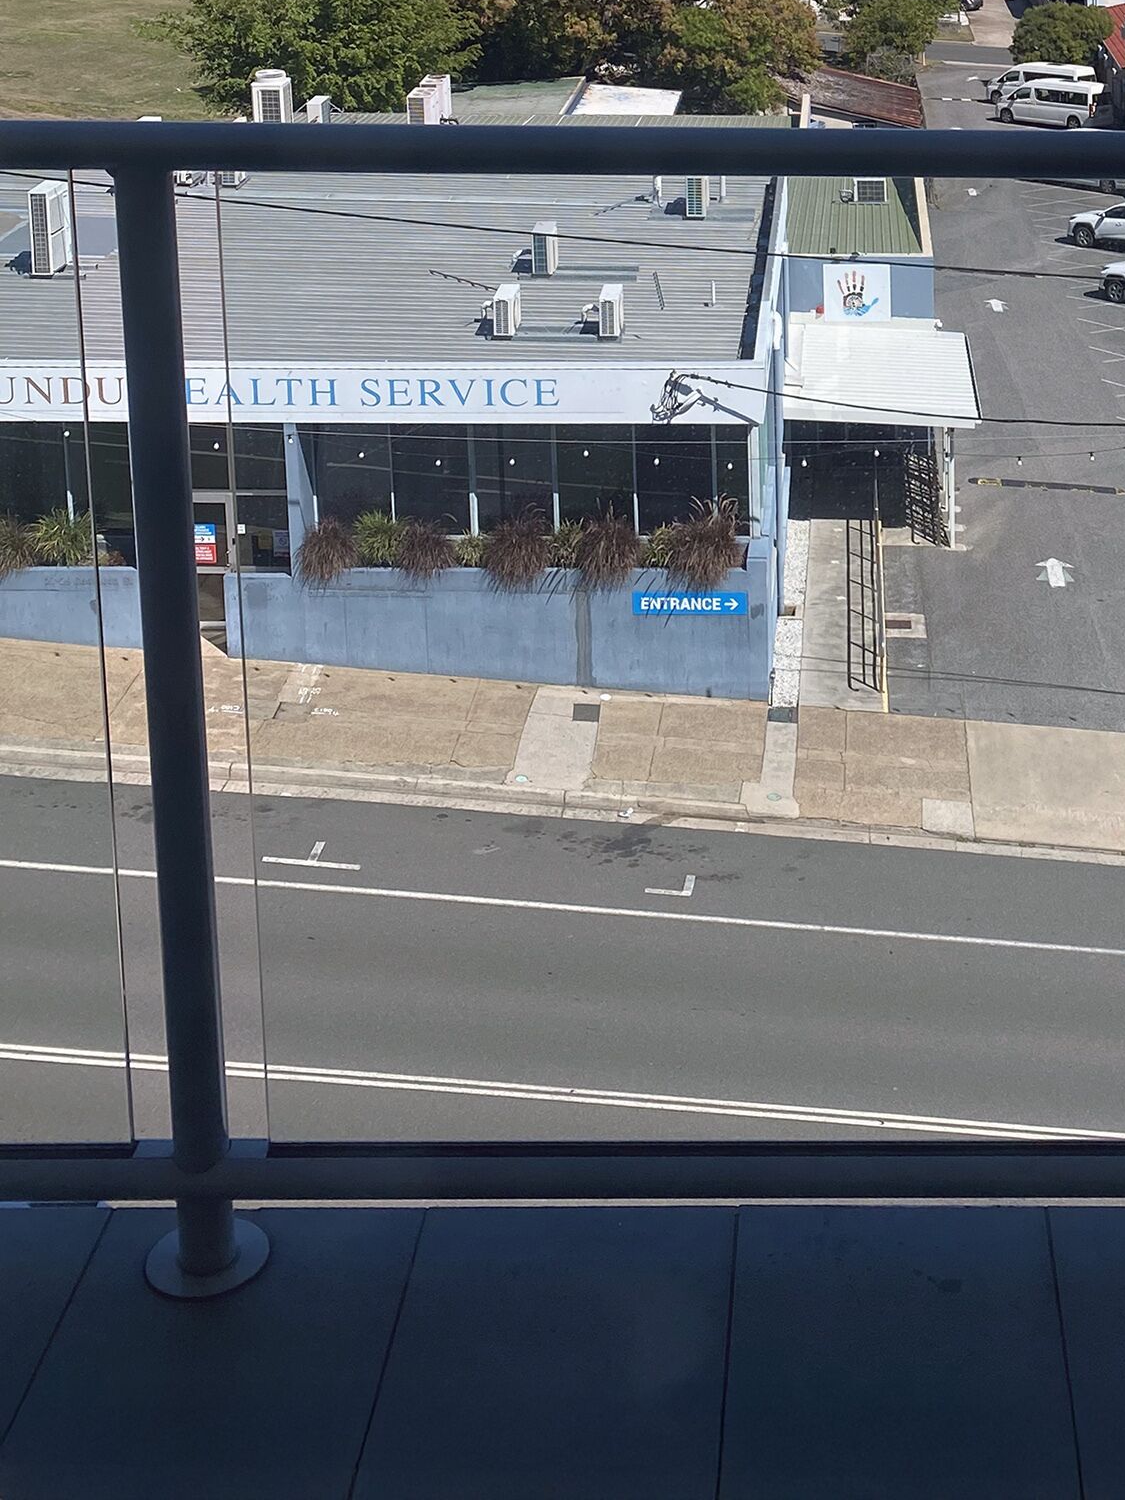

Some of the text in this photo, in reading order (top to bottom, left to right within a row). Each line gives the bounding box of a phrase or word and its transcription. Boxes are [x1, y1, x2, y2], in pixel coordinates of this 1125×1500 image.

[185, 377, 339, 406] EALTH
[360, 378, 560, 407] SERVICE
[640, 596, 722, 611] ENTRANCE
